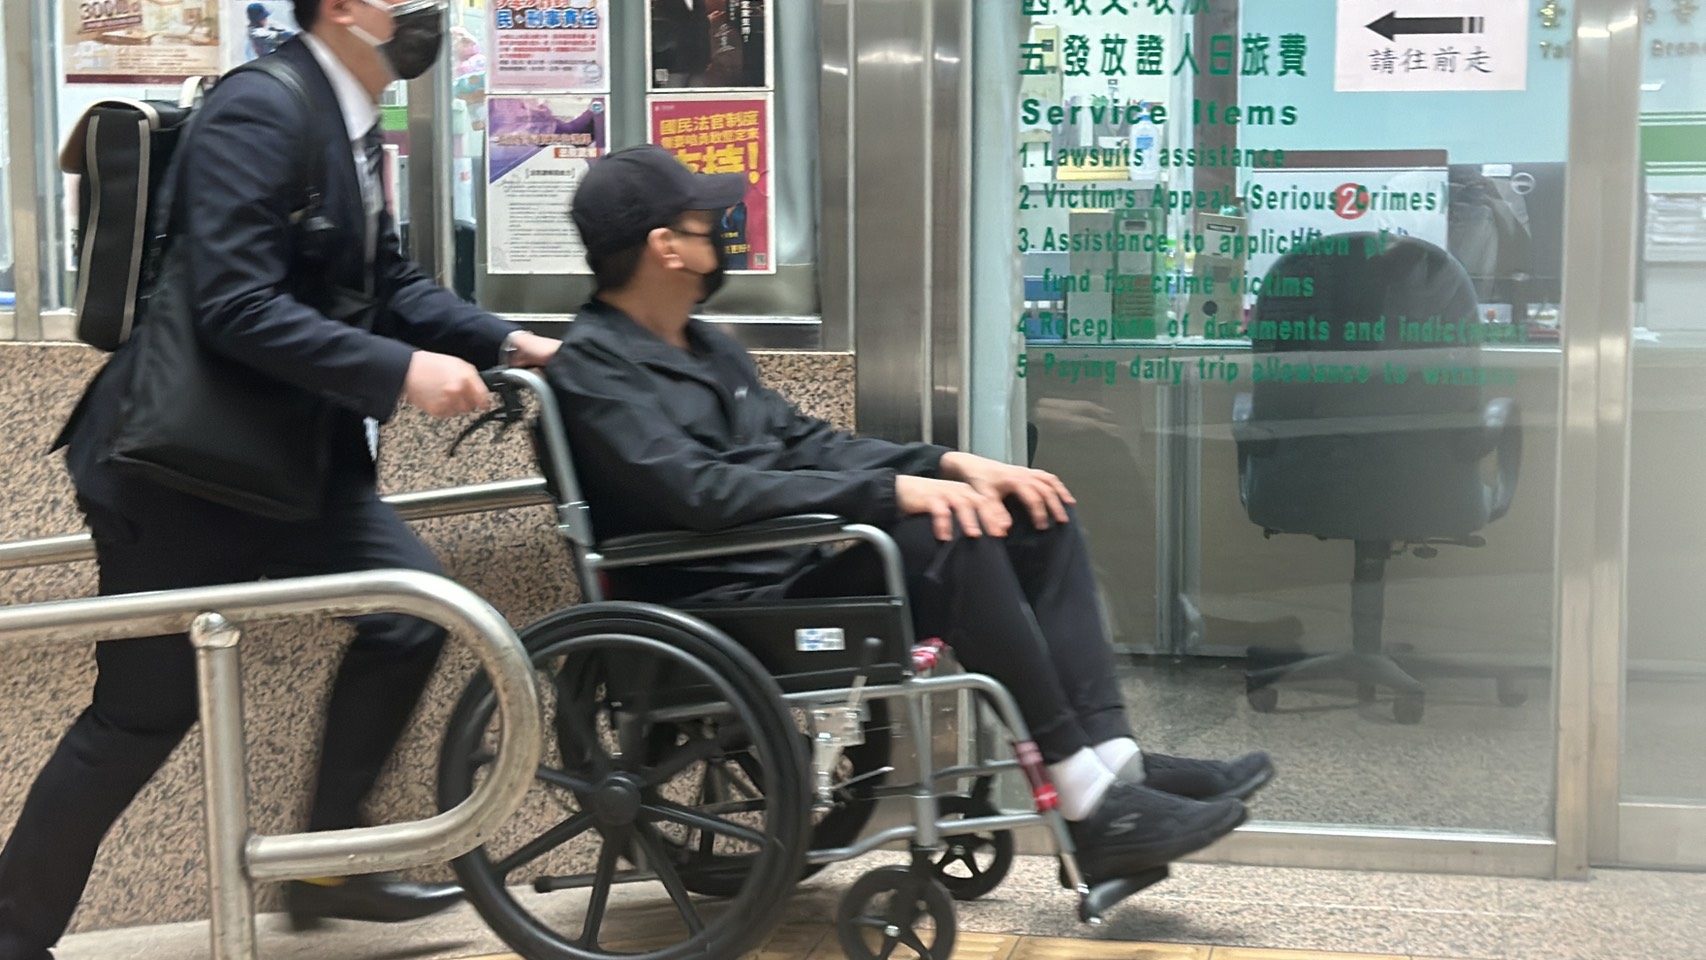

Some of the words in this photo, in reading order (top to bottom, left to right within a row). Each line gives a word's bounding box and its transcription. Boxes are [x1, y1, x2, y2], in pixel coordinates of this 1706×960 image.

[1368, 46, 1493, 74] 請往前走
[660, 110, 759, 135] 國民法官制度
[1021, 99, 1167, 125] Service
[1193, 99, 1298, 126] Items
[1020, 142, 1035, 167] 1.
[1044, 142, 1144, 168] Lawsuits
[1159, 143, 1286, 168] assistance
[1019, 184, 1038, 210] 2.
[1044, 184, 1135, 209] Victim's
[1152, 184, 1231, 214] Appeal
[1243, 181, 1338, 213] (Serious
[1354, 181, 1448, 213] Crimes)
[1018, 227, 1036, 252] 3.
[1042, 227, 1168, 252] Assistance
[1183, 230, 1205, 253] to
[1043, 267, 1091, 292] fund
[1105, 268, 1134, 293] for
[1152, 270, 1215, 294] crime
[1230, 271, 1314, 297] victims
[1167, 312, 1190, 338] of
[1344, 315, 1386, 342] and
[1043, 353, 1117, 385] Paying
[1130, 354, 1184, 385] daily
[1197, 355, 1239, 382] trip
[1252, 357, 1370, 383] allowance
[1384, 363, 1408, 385] to
